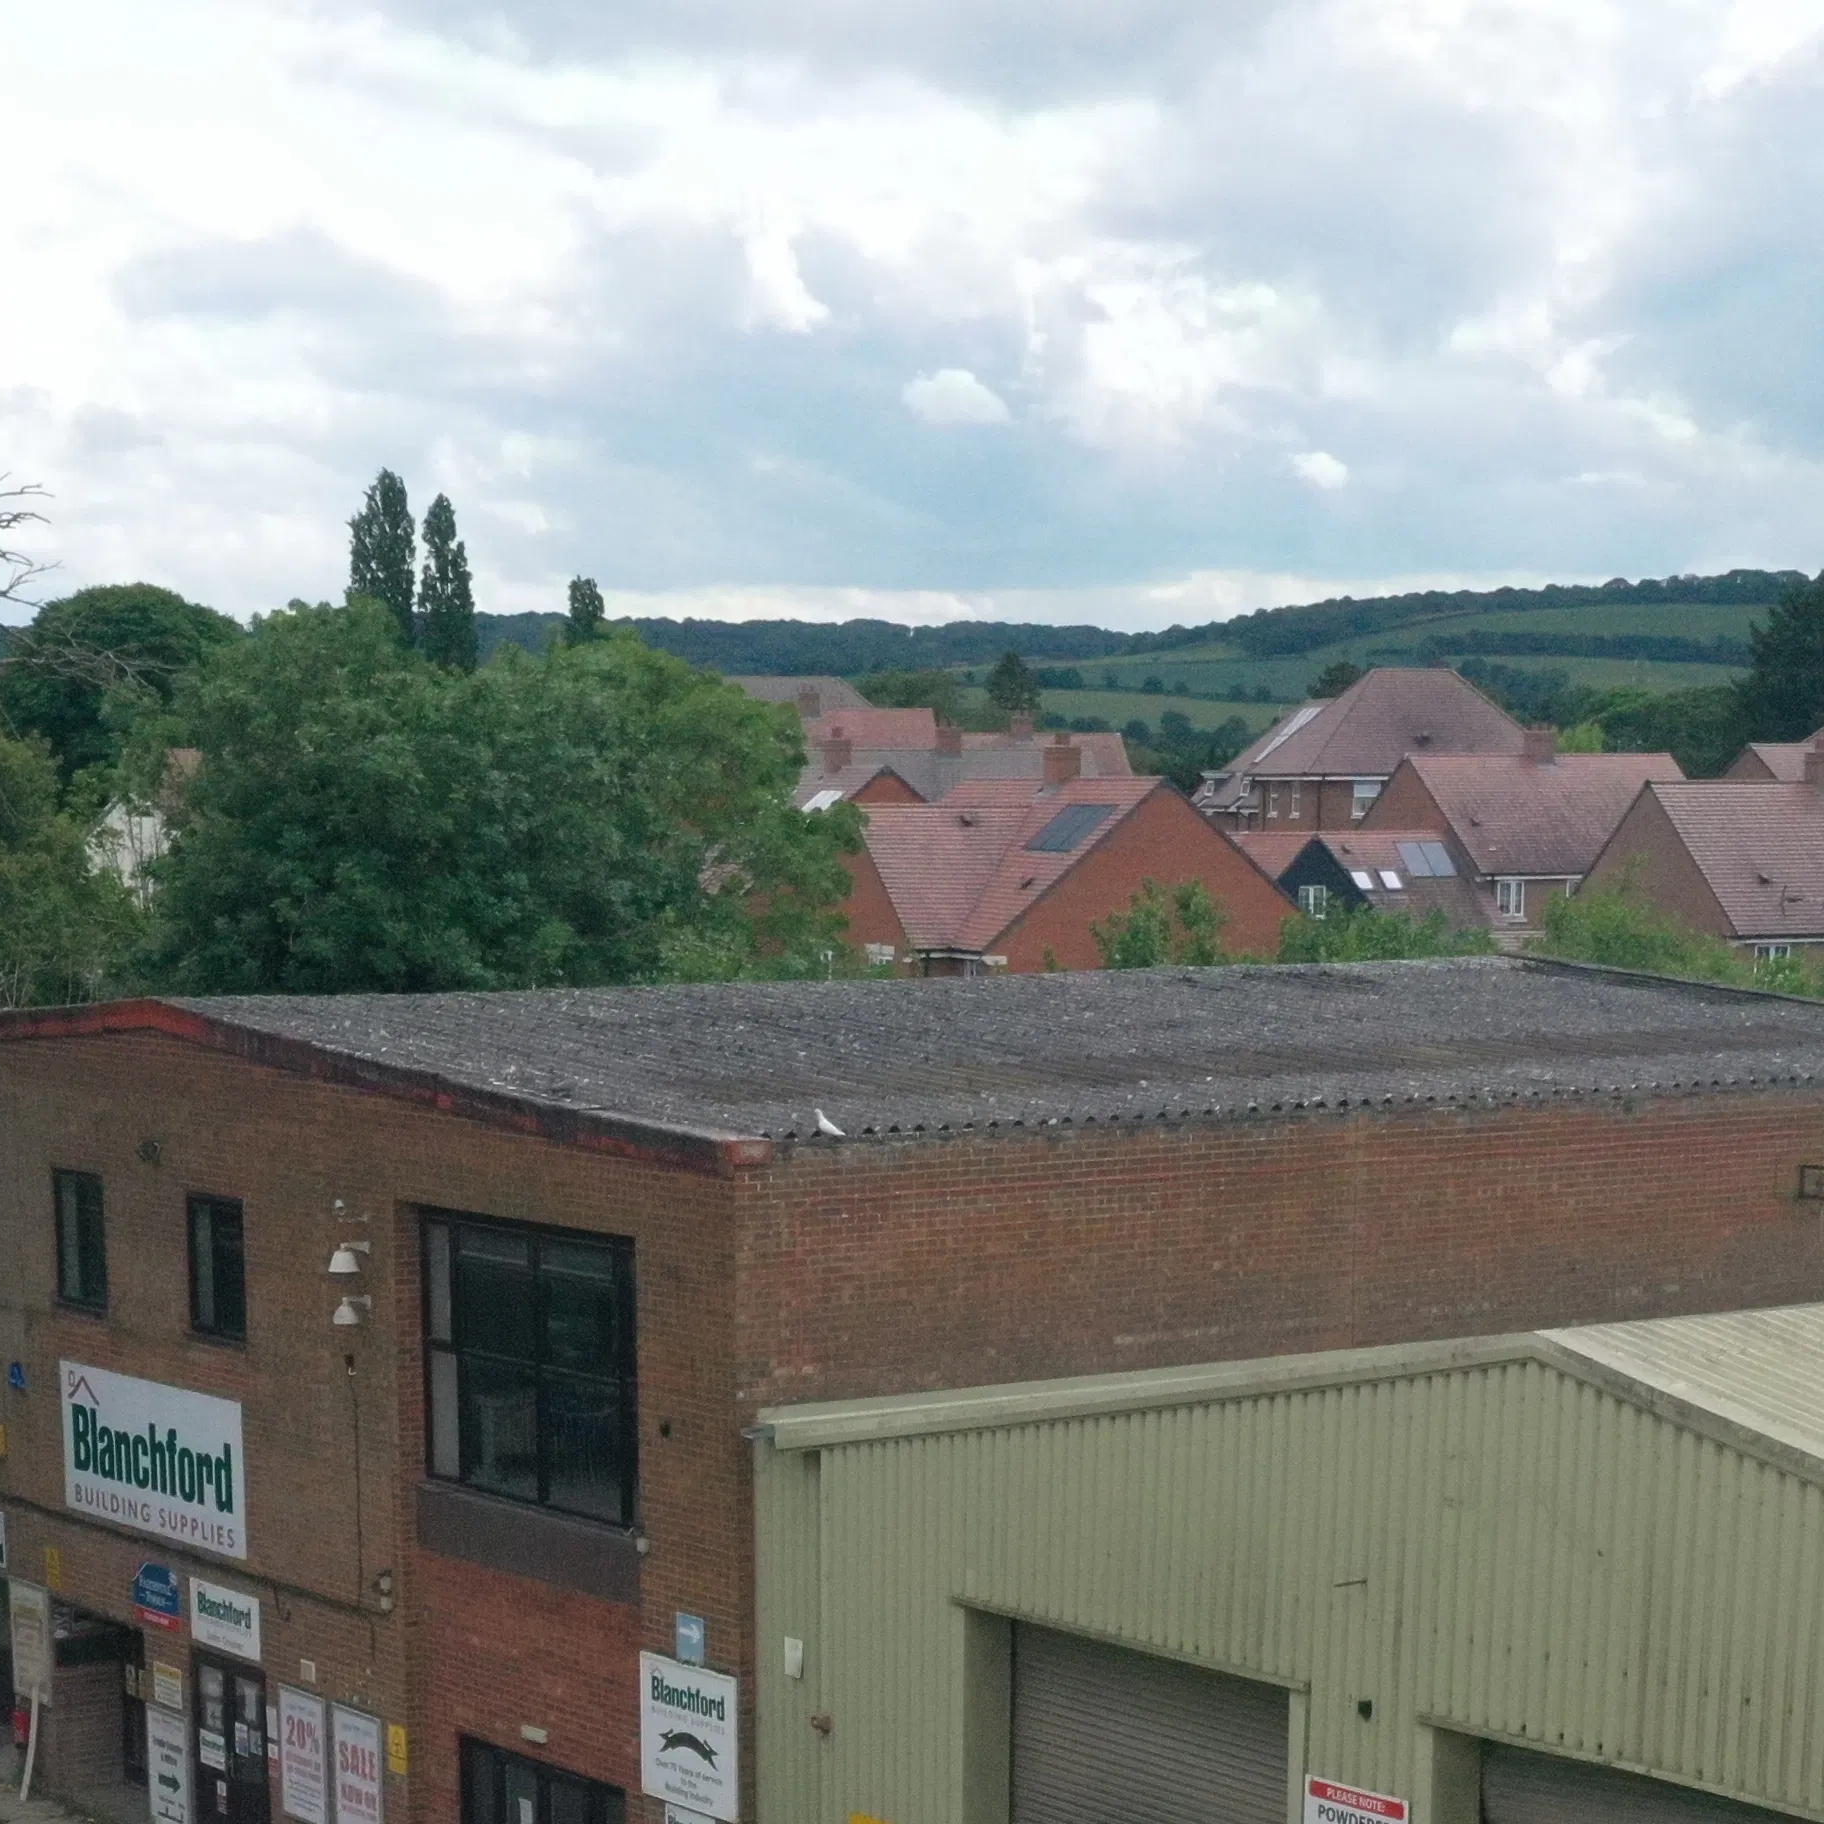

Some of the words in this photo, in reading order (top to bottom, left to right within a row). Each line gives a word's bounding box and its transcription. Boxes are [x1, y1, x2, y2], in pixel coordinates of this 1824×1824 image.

[71, 1402, 233, 1515] Blanchford
[74, 1484, 151, 1524] BUILDING
[158, 1508, 236, 1549] SUPPLIES
[197, 1590, 252, 1630] Blanchford
[651, 1675, 725, 1722] Blanchford
[286, 1714, 321, 1755] 20%
[339, 1740, 376, 1783] SALE
[1326, 1787, 1357, 1805] PLEASE
[1359, 1796, 1386, 1812] NOTE:
